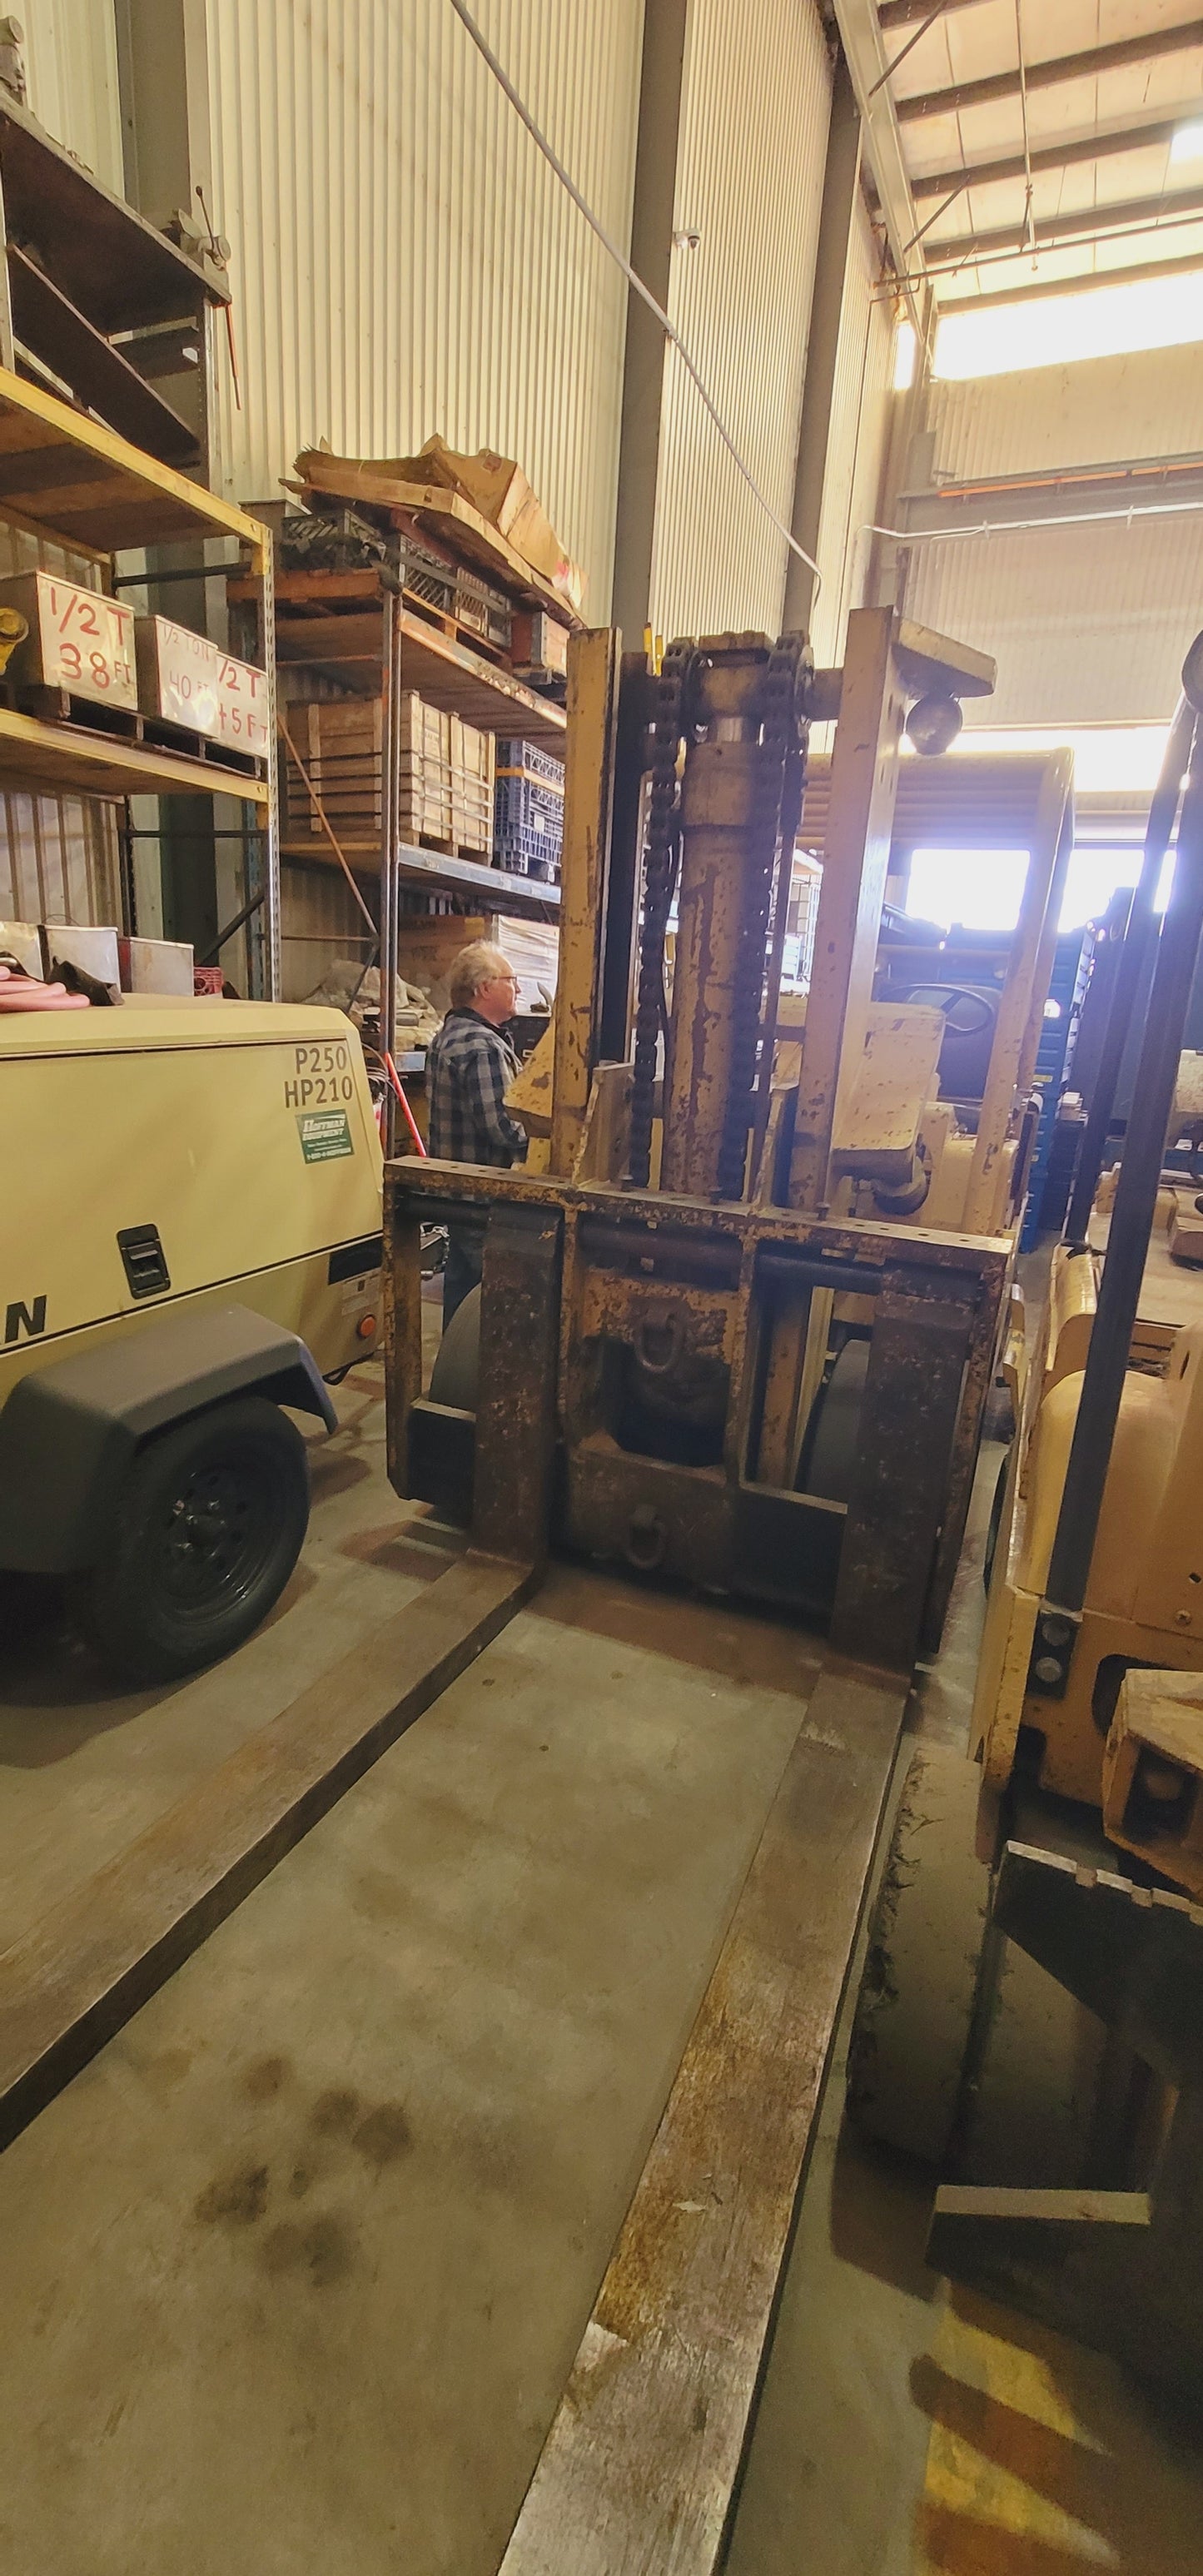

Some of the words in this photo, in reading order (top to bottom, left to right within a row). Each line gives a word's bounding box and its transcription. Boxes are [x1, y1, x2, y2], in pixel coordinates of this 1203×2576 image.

[51, 587, 100, 636] 1/2
[107, 606, 132, 646] T
[59, 643, 110, 689] 38
[114, 660, 131, 684] FT
[170, 670, 191, 699] 40
[246, 669, 261, 698] T
[247, 714, 268, 743] FT
[296, 1046, 347, 1074] P250
[284, 1076, 353, 1108] HP210
